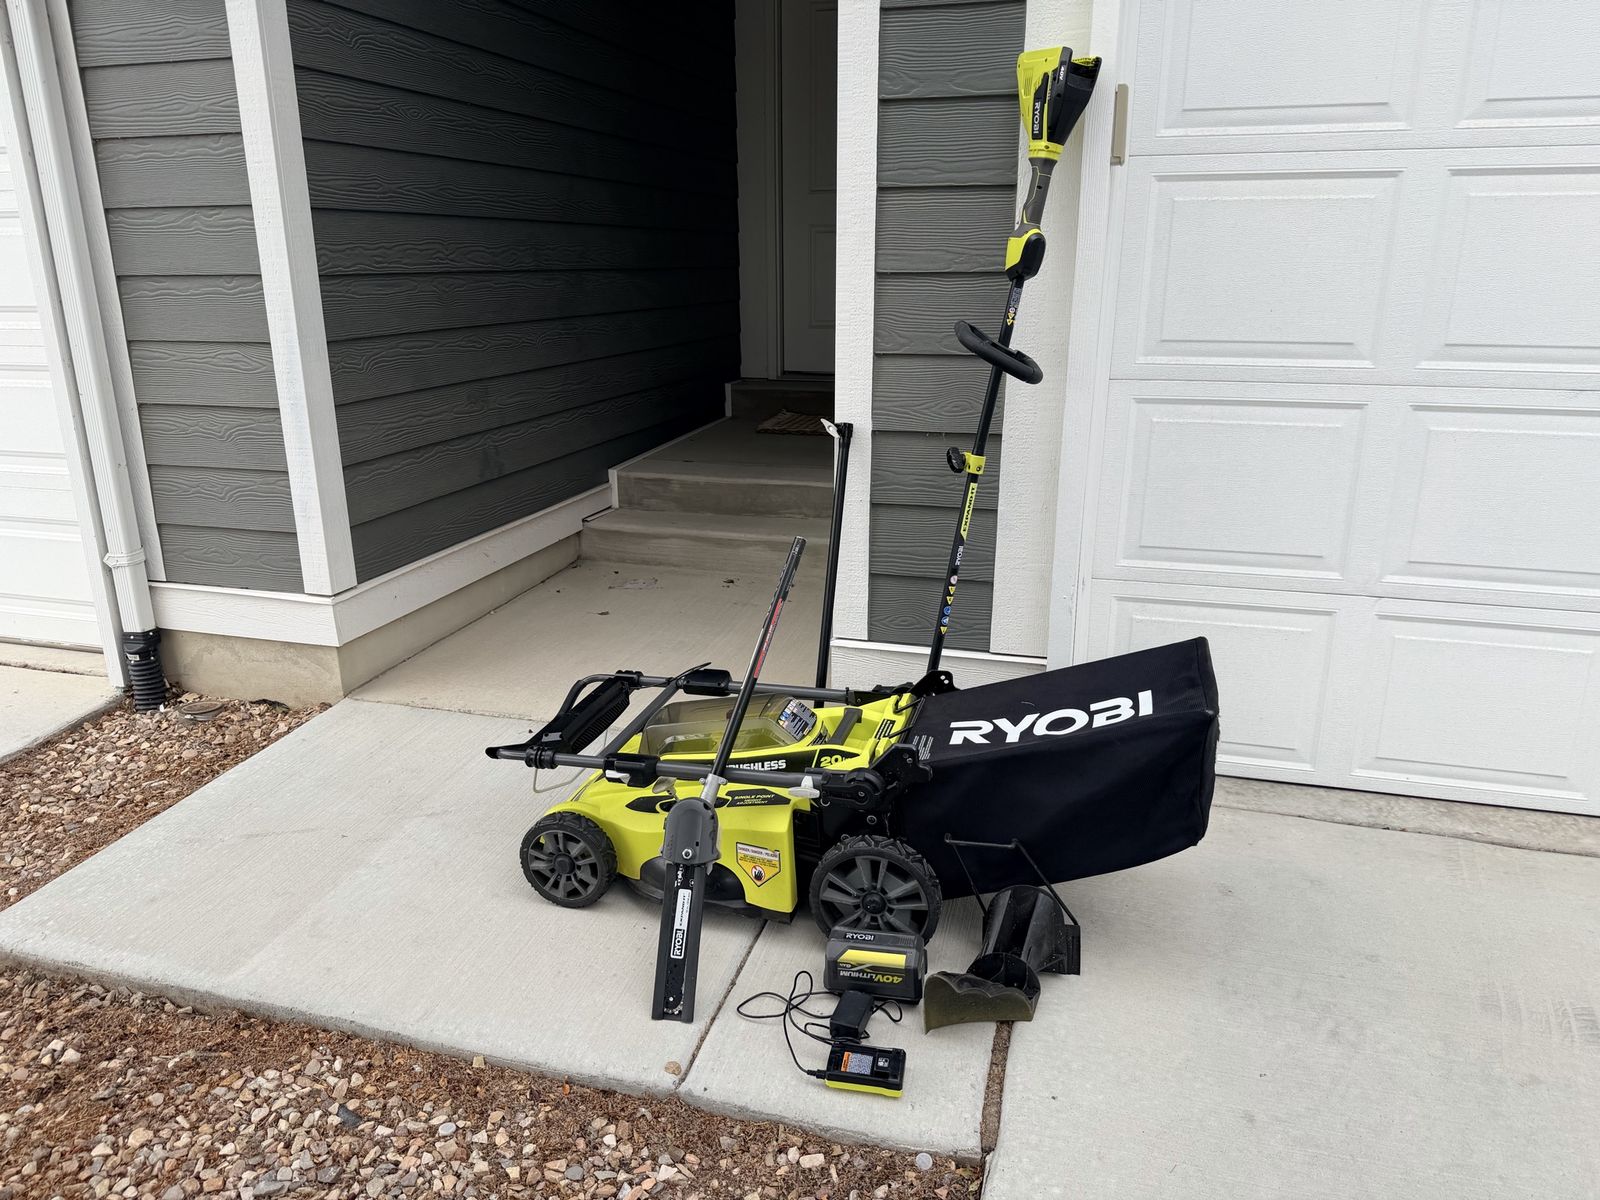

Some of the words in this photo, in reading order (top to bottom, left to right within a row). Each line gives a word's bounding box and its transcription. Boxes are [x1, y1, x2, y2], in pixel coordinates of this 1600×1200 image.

[1033, 102, 1041, 133] RYOBI
[955, 546, 963, 565] RYOBI
[949, 690, 1153, 745] RYOBI
[674, 929, 684, 956] RYOBI
[846, 932, 874, 941] RYOBI
[840, 970, 876, 979] LITHIUM
[874, 974, 903, 984] 40V
